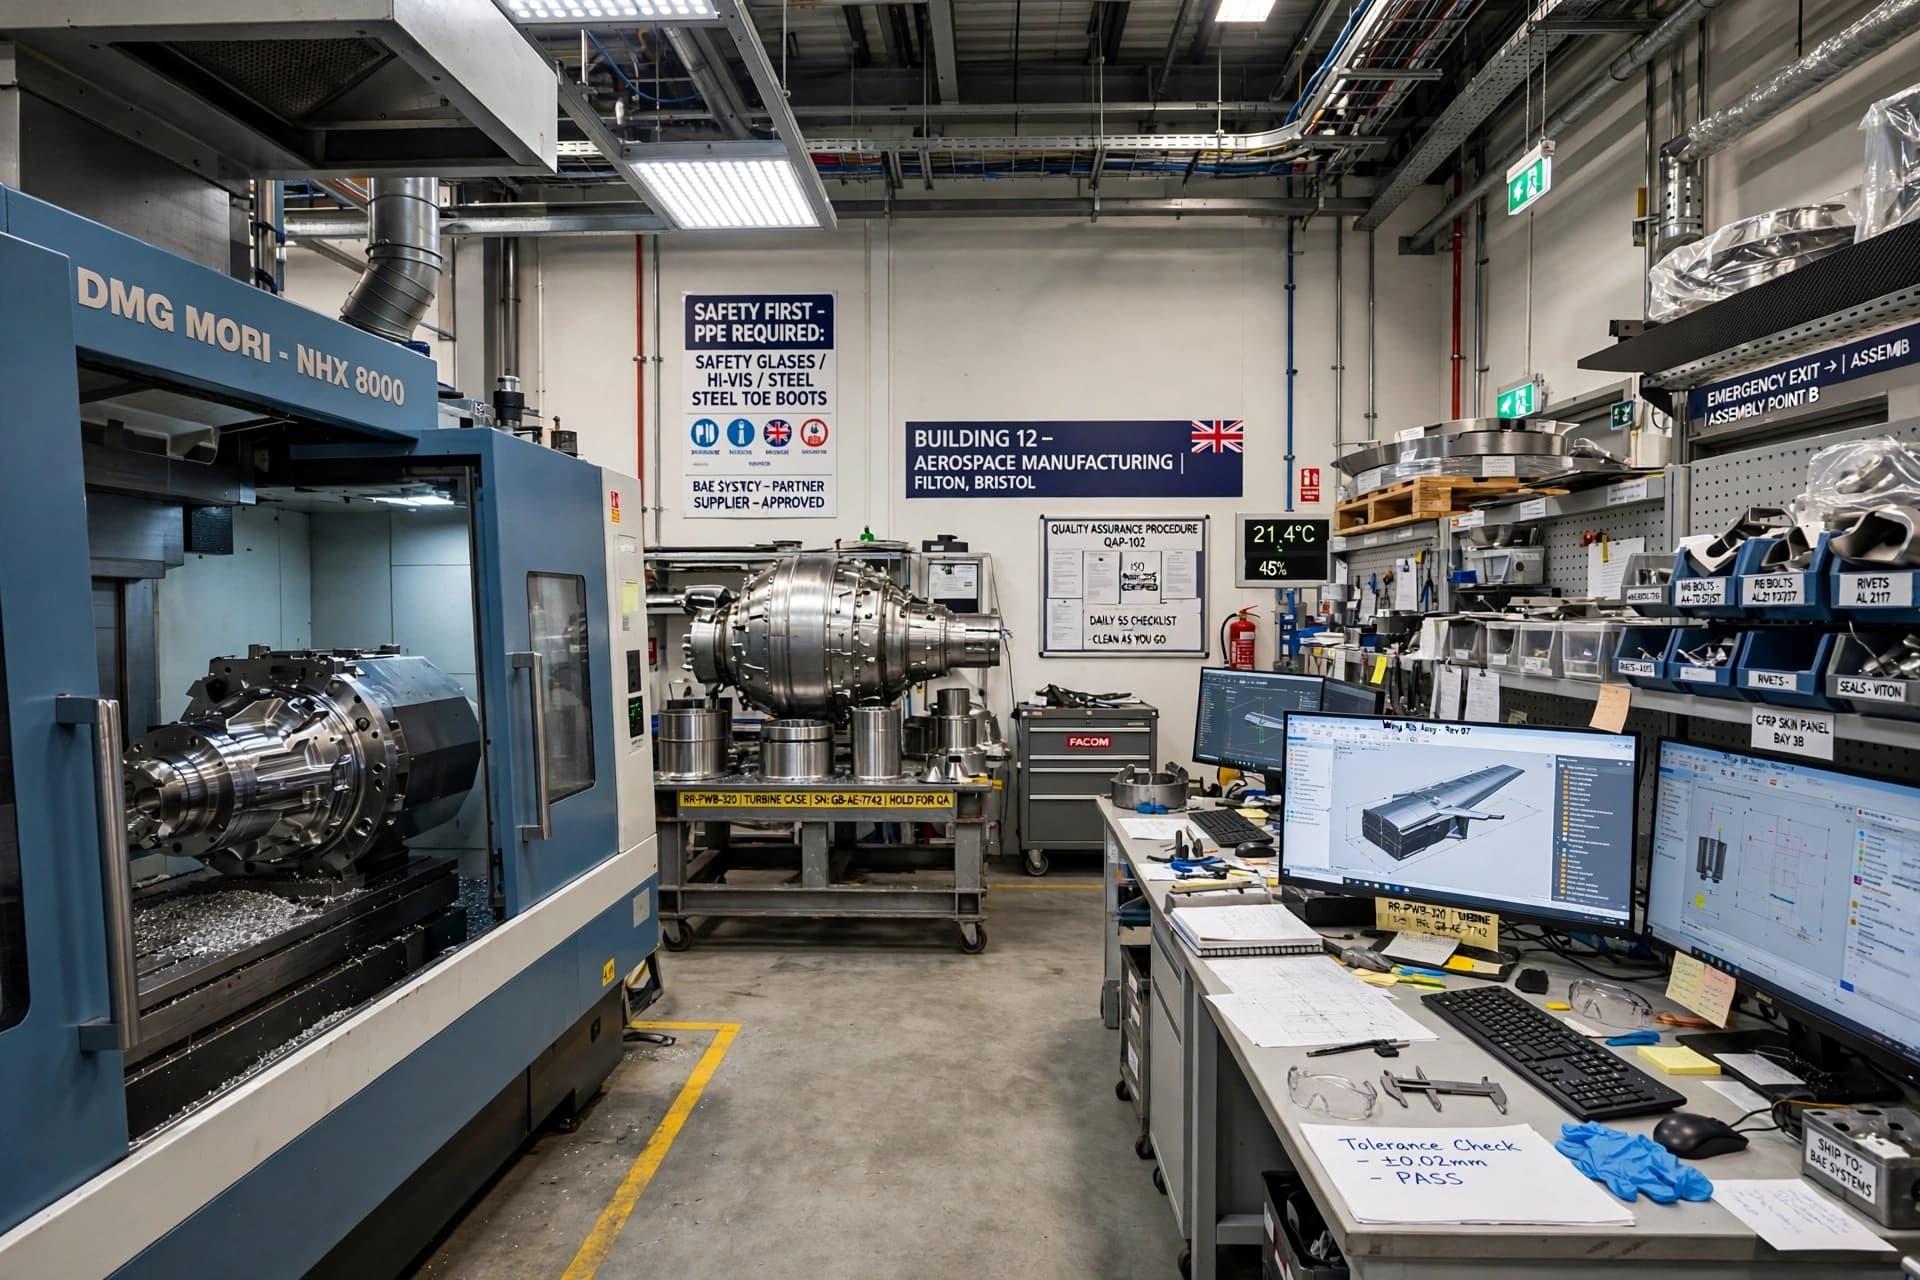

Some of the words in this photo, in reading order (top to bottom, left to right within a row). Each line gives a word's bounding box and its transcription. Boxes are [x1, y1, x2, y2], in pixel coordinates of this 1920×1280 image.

[694, 303, 759, 321] SAFETY
[765, 302, 813, 320] FIRST
[77, 266, 175, 332] DMG
[185, 304, 272, 364] MORI
[297, 344, 349, 389] NHX
[356, 365, 405, 406] 8000
[694, 324, 727, 343] PPE
[732, 324, 825, 344] REQUIRED:
[696, 355, 753, 370] SAFETY
[757, 354, 816, 370] GLASES
[707, 373, 753, 388] HI-VIS
[768, 372, 814, 388] STEEL
[1707, 371, 1787, 407] EMERGENCY
[1789, 362, 1820, 386] EXIT
[692, 391, 738, 406] STEEL
[742, 391, 772, 406] TOE
[776, 391, 827, 406] BOOTS
[1708, 399, 1765, 426] ASSEMBLY
[1768, 389, 1806, 412] POINT
[1809, 386, 1820, 403] B
[914, 429, 1010, 448] BUILDING
[1016, 429, 1038, 447] 12
[914, 454, 1017, 471] AEROSPACE
[1022, 454, 1174, 470] MANUFACTURING
[693, 480, 715, 492] BAE
[772, 480, 825, 492] PARTNER
[914, 475, 970, 492] FILTON,
[975, 475, 1036, 490] BRISTOL
[694, 496, 750, 510] SUPPLIER
[761, 496, 825, 509] APPROVED
[1051, 524, 1089, 535] QUALITY
[1091, 524, 1143, 535] ASSURANCE
[1146, 524, 1198, 535] PROCEDURE
[1253, 524, 1315, 544] 21.4°C
[1104, 537, 1146, 548] QAP-102
[1130, 562, 1145, 572] ISO
[1259, 560, 1287, 576] 45%
[1693, 581, 1715, 592] BOLTS
[1767, 578, 1793, 589] BOLTS
[1857, 577, 1889, 589] RIVETS
[1856, 592, 1867, 604] AL
[1870, 592, 1891, 604] 2117
[1090, 616, 1115, 626] DAILY
[1131, 616, 1177, 626] CHECKLIST
[1092, 634, 1119, 645] CLEAN
[1121, 634, 1132, 644] AS
[1135, 634, 1152, 644] YOU
[1154, 635, 1166, 645] GO
[1840, 681, 1866, 695] SEALS
[1873, 683, 1902, 697] VITON
[1779, 717, 1798, 731] SKIN
[1800, 720, 1830, 735] PANEL
[1070, 738, 1109, 747] FACOM
[1774, 733, 1791, 746] BAY
[1793, 735, 1804, 747] 3B
[744, 795, 782, 805] TURBINE
[784, 795, 807, 805] CASE
[814, 795, 830, 805] SN:
[831, 795, 882, 805] GB-AE-7742
[890, 795, 913, 805] HOLD
[916, 795, 934, 805] FOR
[937, 795, 950, 805] QA
[1338, 1138, 1442, 1152] Tolerance
[1454, 1139, 1523, 1152] Check
[1382, 1156, 1488, 1168] ±0.02mm
[1818, 1138, 1841, 1160] SHIP
[1844, 1155, 1863, 1174] TO:
[1396, 1171, 1463, 1186] PASS
[1810, 1149, 1827, 1169] BAE
[1830, 1162, 1873, 1198] SYSTEMS
